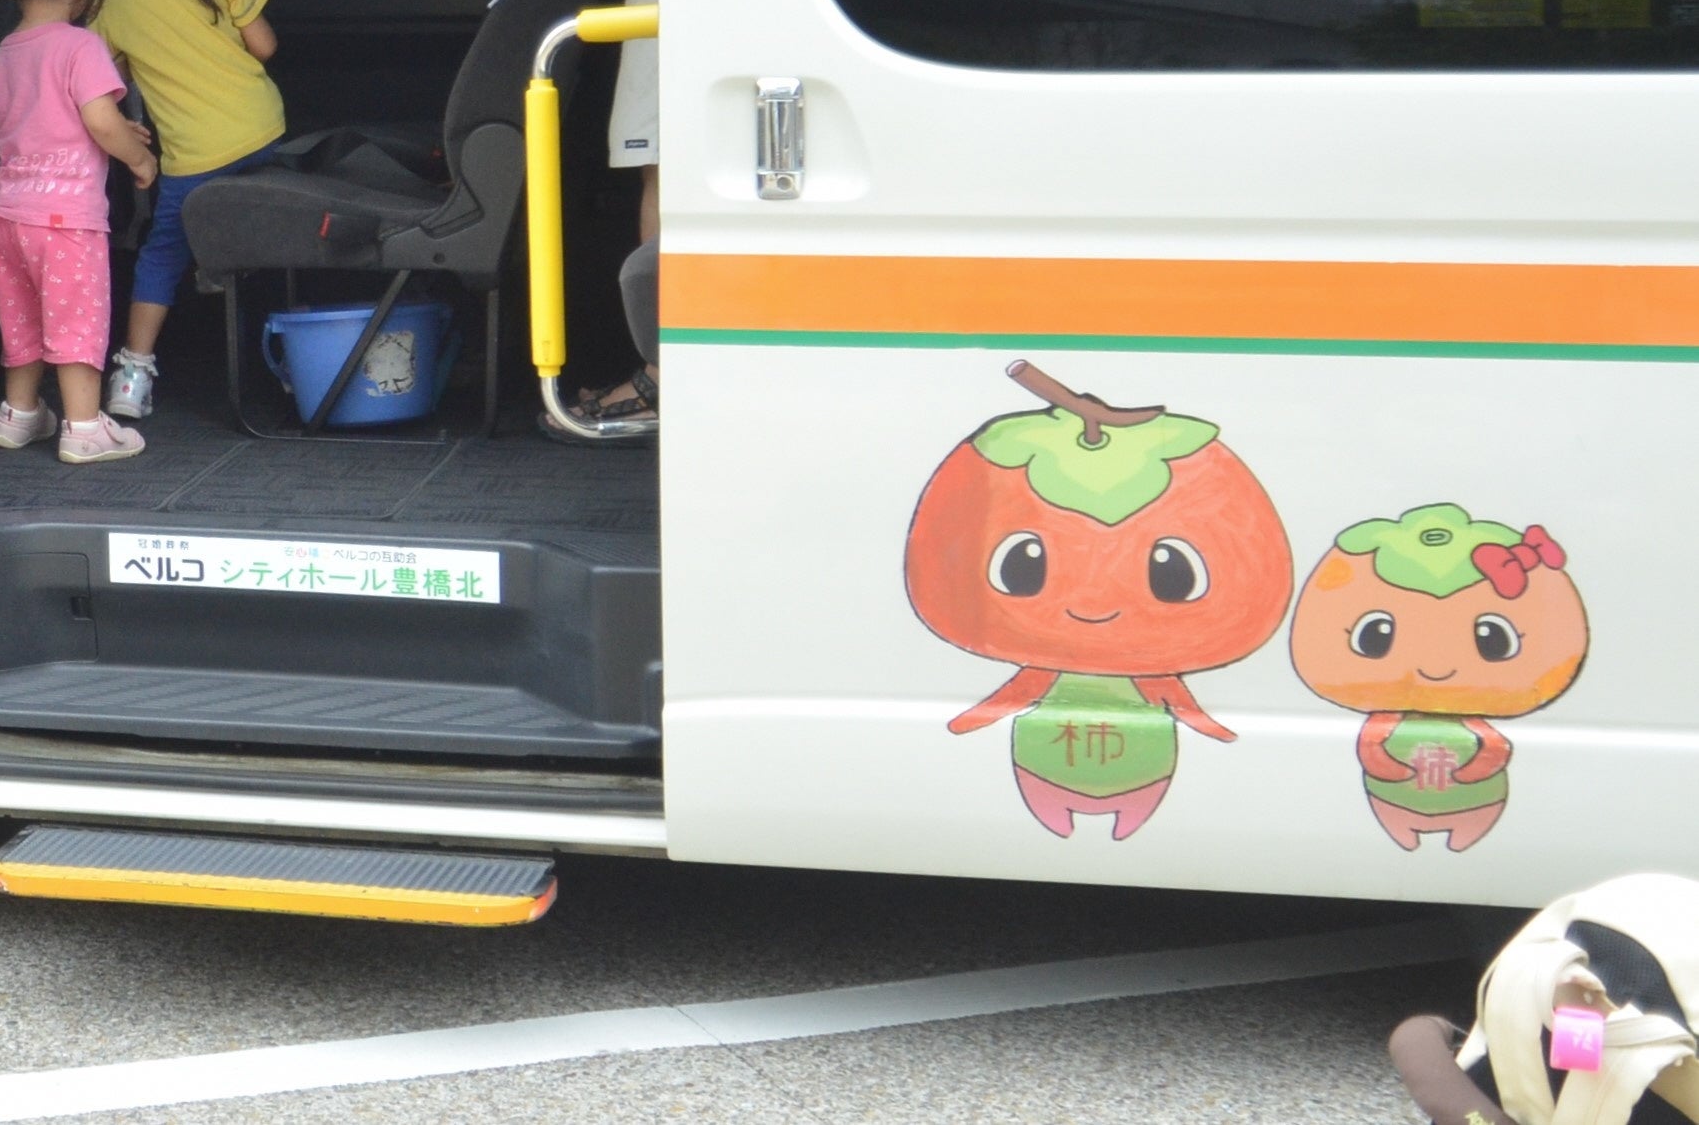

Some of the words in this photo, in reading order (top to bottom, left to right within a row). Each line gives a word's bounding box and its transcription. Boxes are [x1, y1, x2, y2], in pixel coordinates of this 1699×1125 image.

[123, 556, 205, 582] ベルコ
[218, 558, 484, 599] シティホール豊橋北
[333, 548, 418, 565] ベルコの互助会
[1048, 720, 1126, 768] 柿
